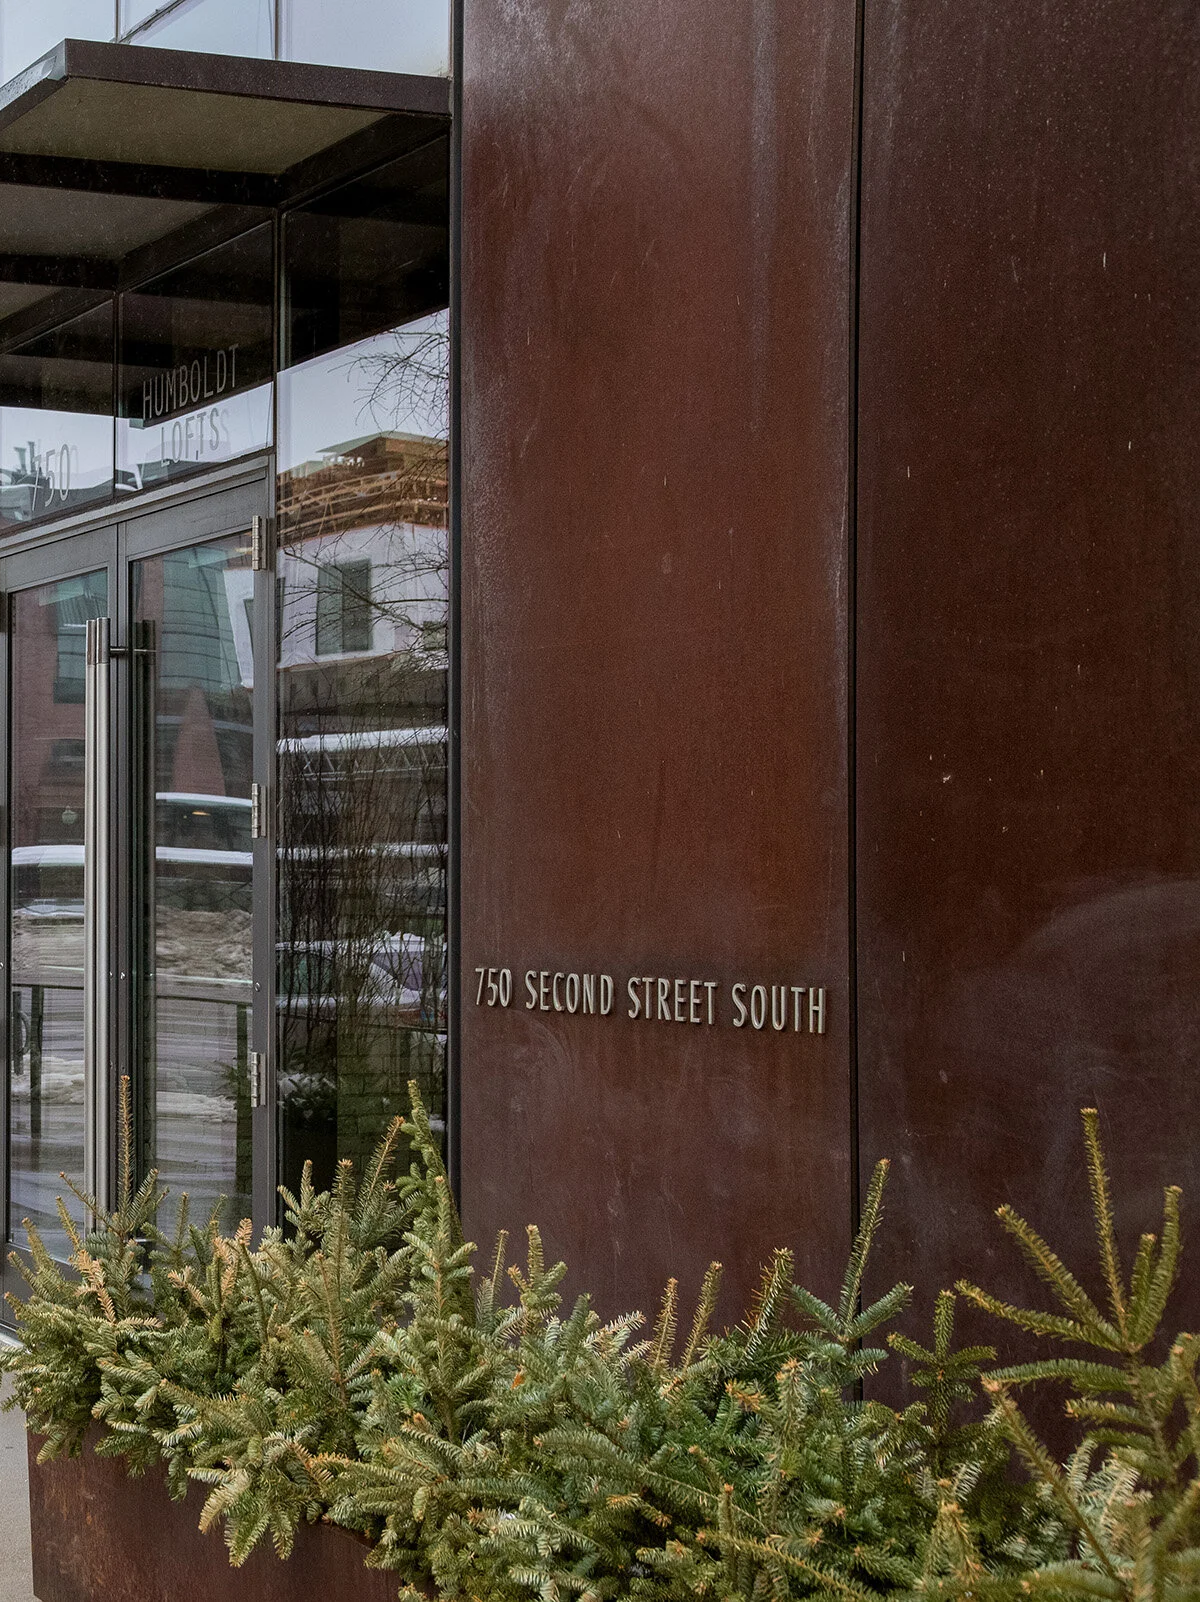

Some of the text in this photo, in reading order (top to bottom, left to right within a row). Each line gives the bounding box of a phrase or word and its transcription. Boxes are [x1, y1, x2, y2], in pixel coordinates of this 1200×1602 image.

[142, 344, 240, 421] HUMBOLDT
[159, 407, 220, 468] LOFTS
[31, 443, 70, 512] 750
[475, 967, 827, 1034] 750 SECOND STREET SOUTH
